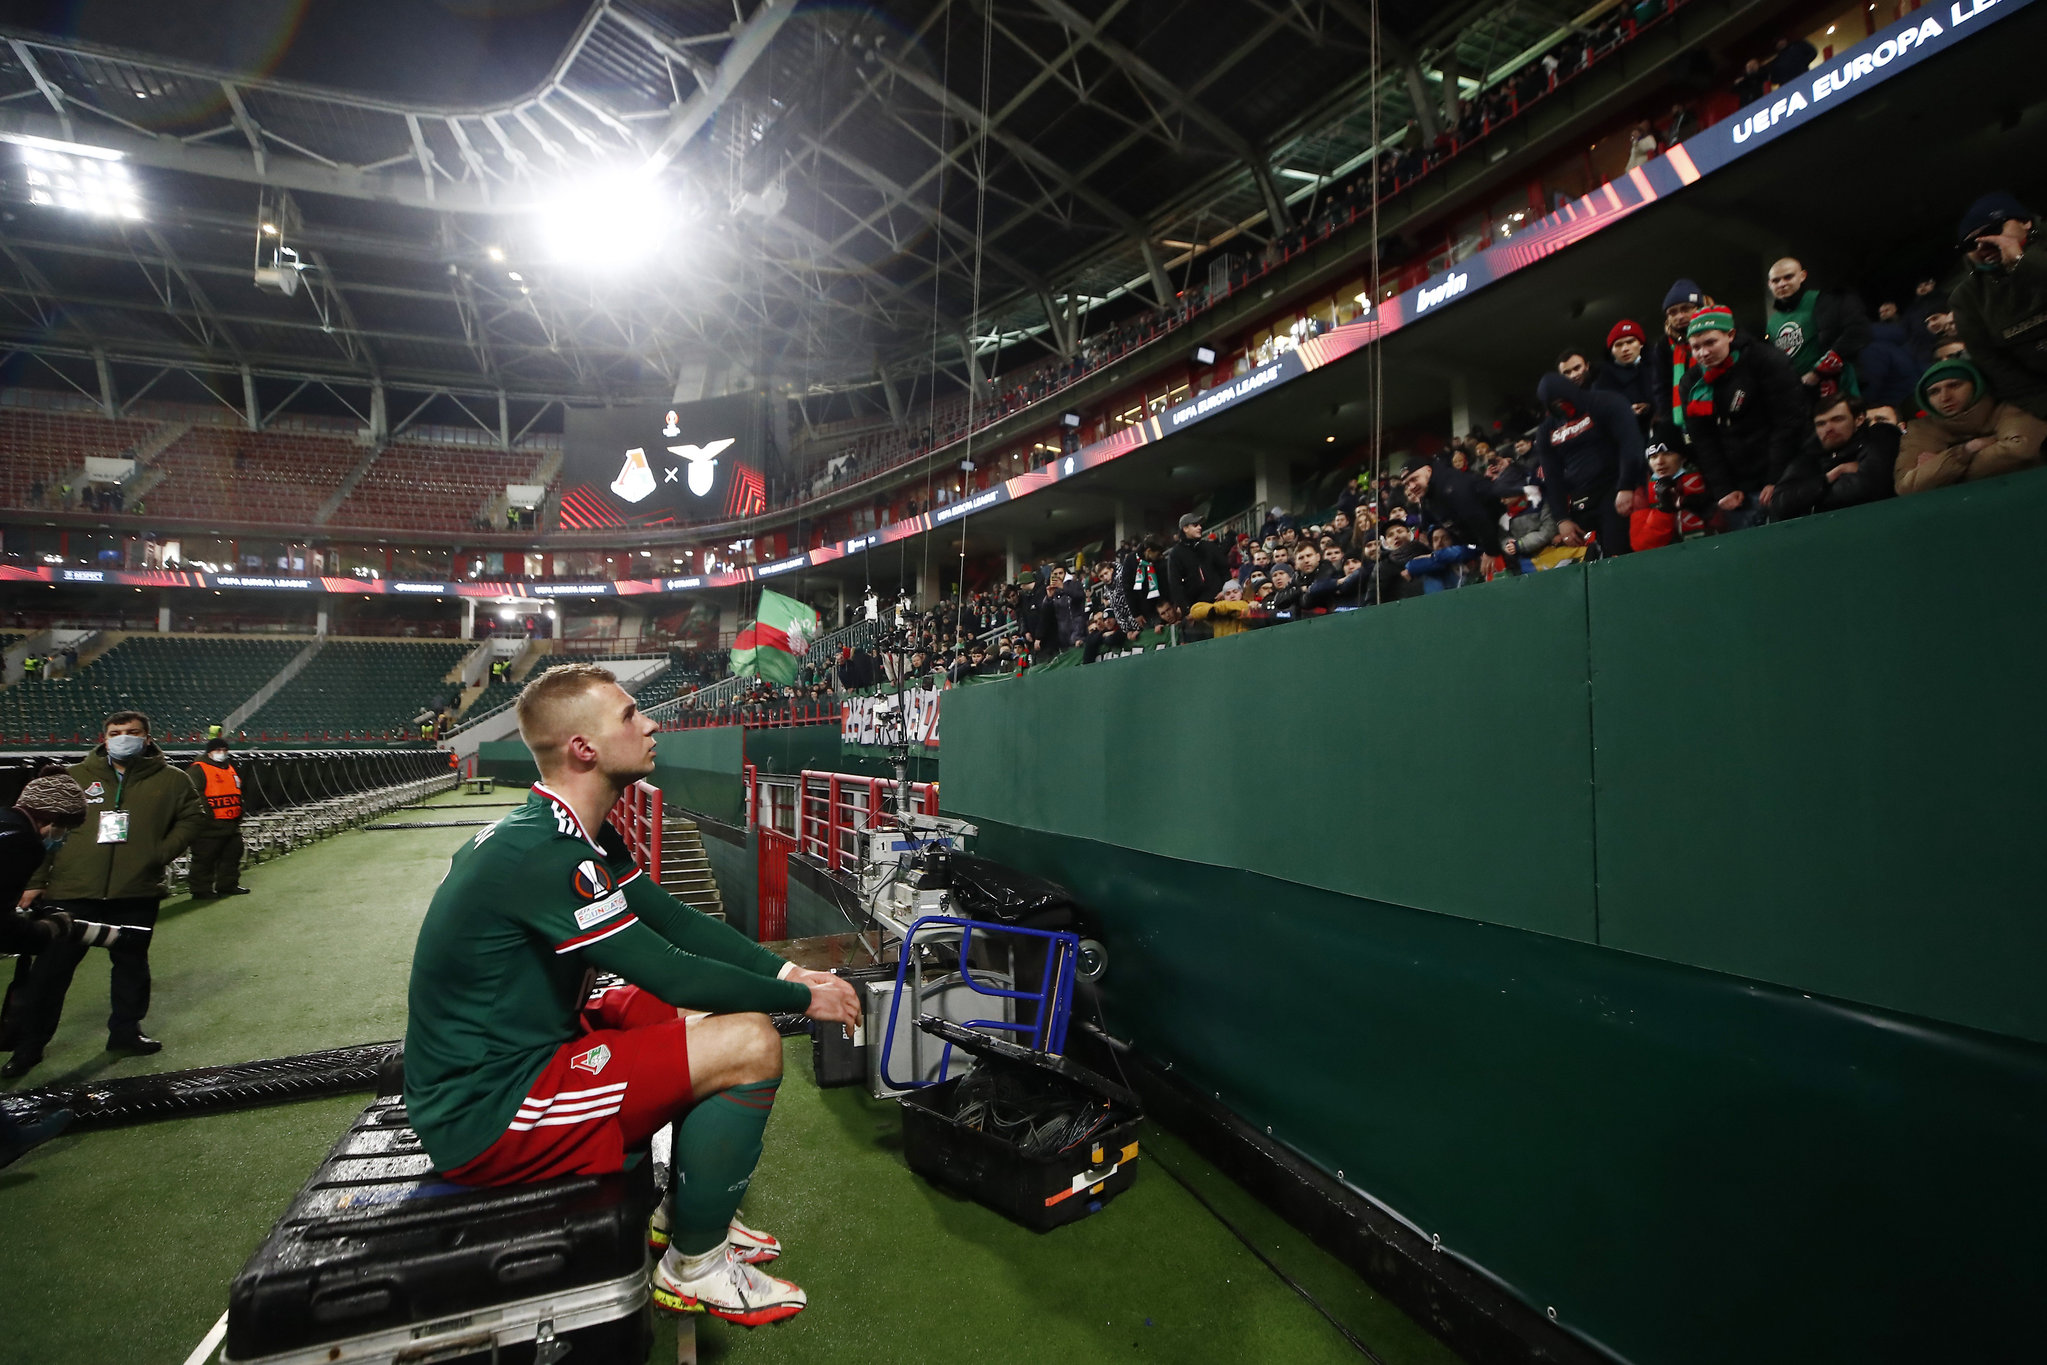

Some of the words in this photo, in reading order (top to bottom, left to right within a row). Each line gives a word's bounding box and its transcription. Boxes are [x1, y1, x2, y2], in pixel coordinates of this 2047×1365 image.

[1732, 91, 1808, 144] UEFA
[1811, 16, 1944, 103] EUROPA
[1416, 272, 1468, 313] bwin
[1173, 405, 1198, 425] UEFA
[1197, 386, 1236, 415] EUROPA
[1235, 365, 1278, 397] LEAGUE
[1552, 416, 1591, 443] Supreme
[217, 577, 241, 586] UEFA
[241, 578, 276, 587] EUROPA
[275, 579, 308, 589] LEAGUE
[880, 841, 886, 851] 1
